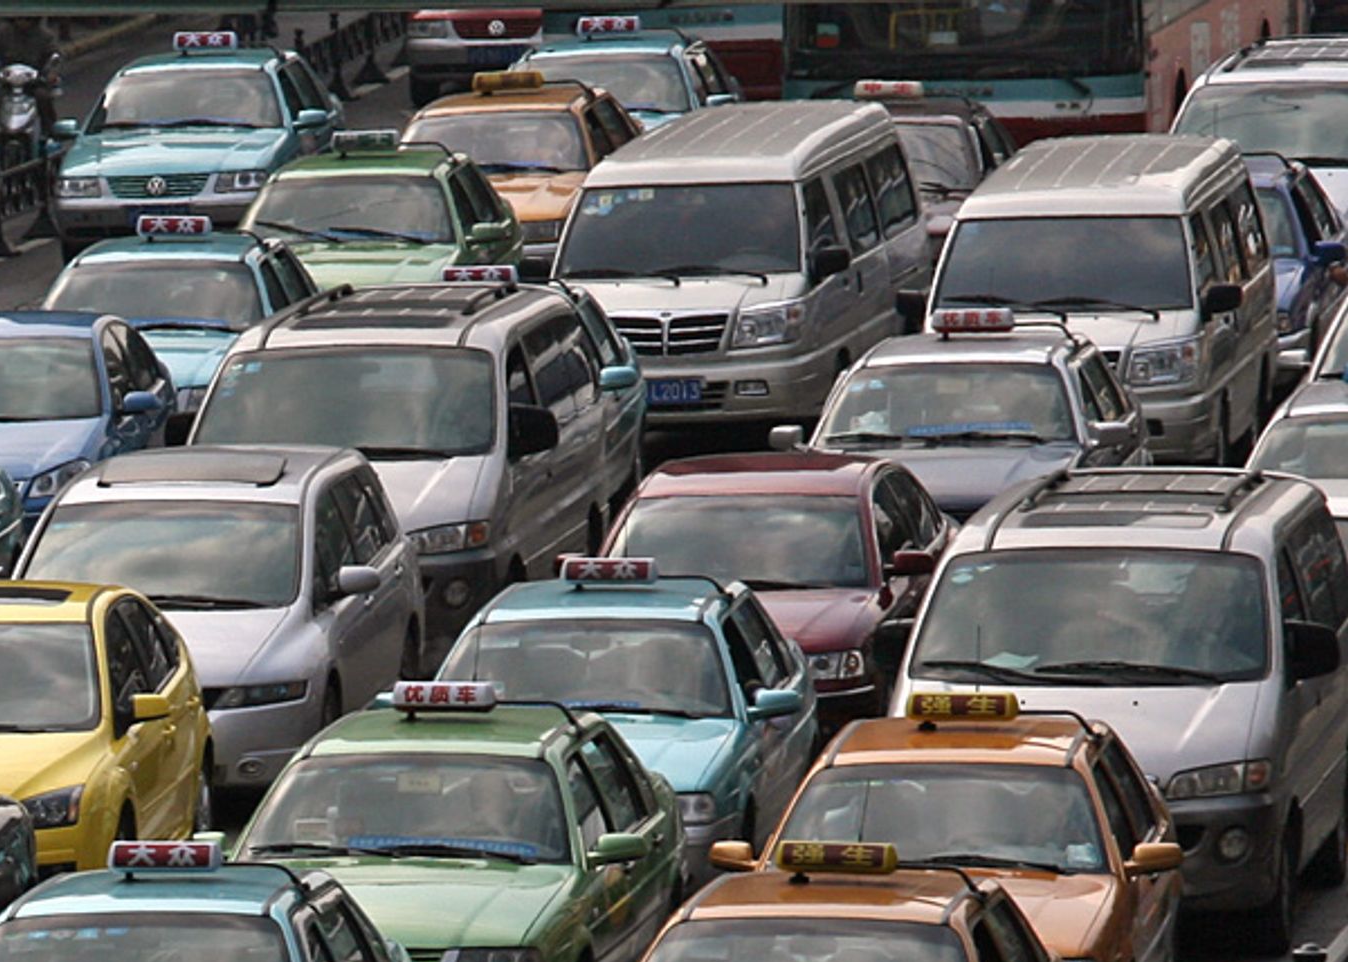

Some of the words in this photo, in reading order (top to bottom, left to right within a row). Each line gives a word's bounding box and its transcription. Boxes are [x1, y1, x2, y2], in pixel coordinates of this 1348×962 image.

[149, 219, 196, 233] 大众
[578, 560, 637, 579] 大众
[403, 685, 477, 704] 优质车
[921, 694, 997, 713] 强生
[127, 843, 196, 866] 大众
[792, 844, 876, 865] 强生
